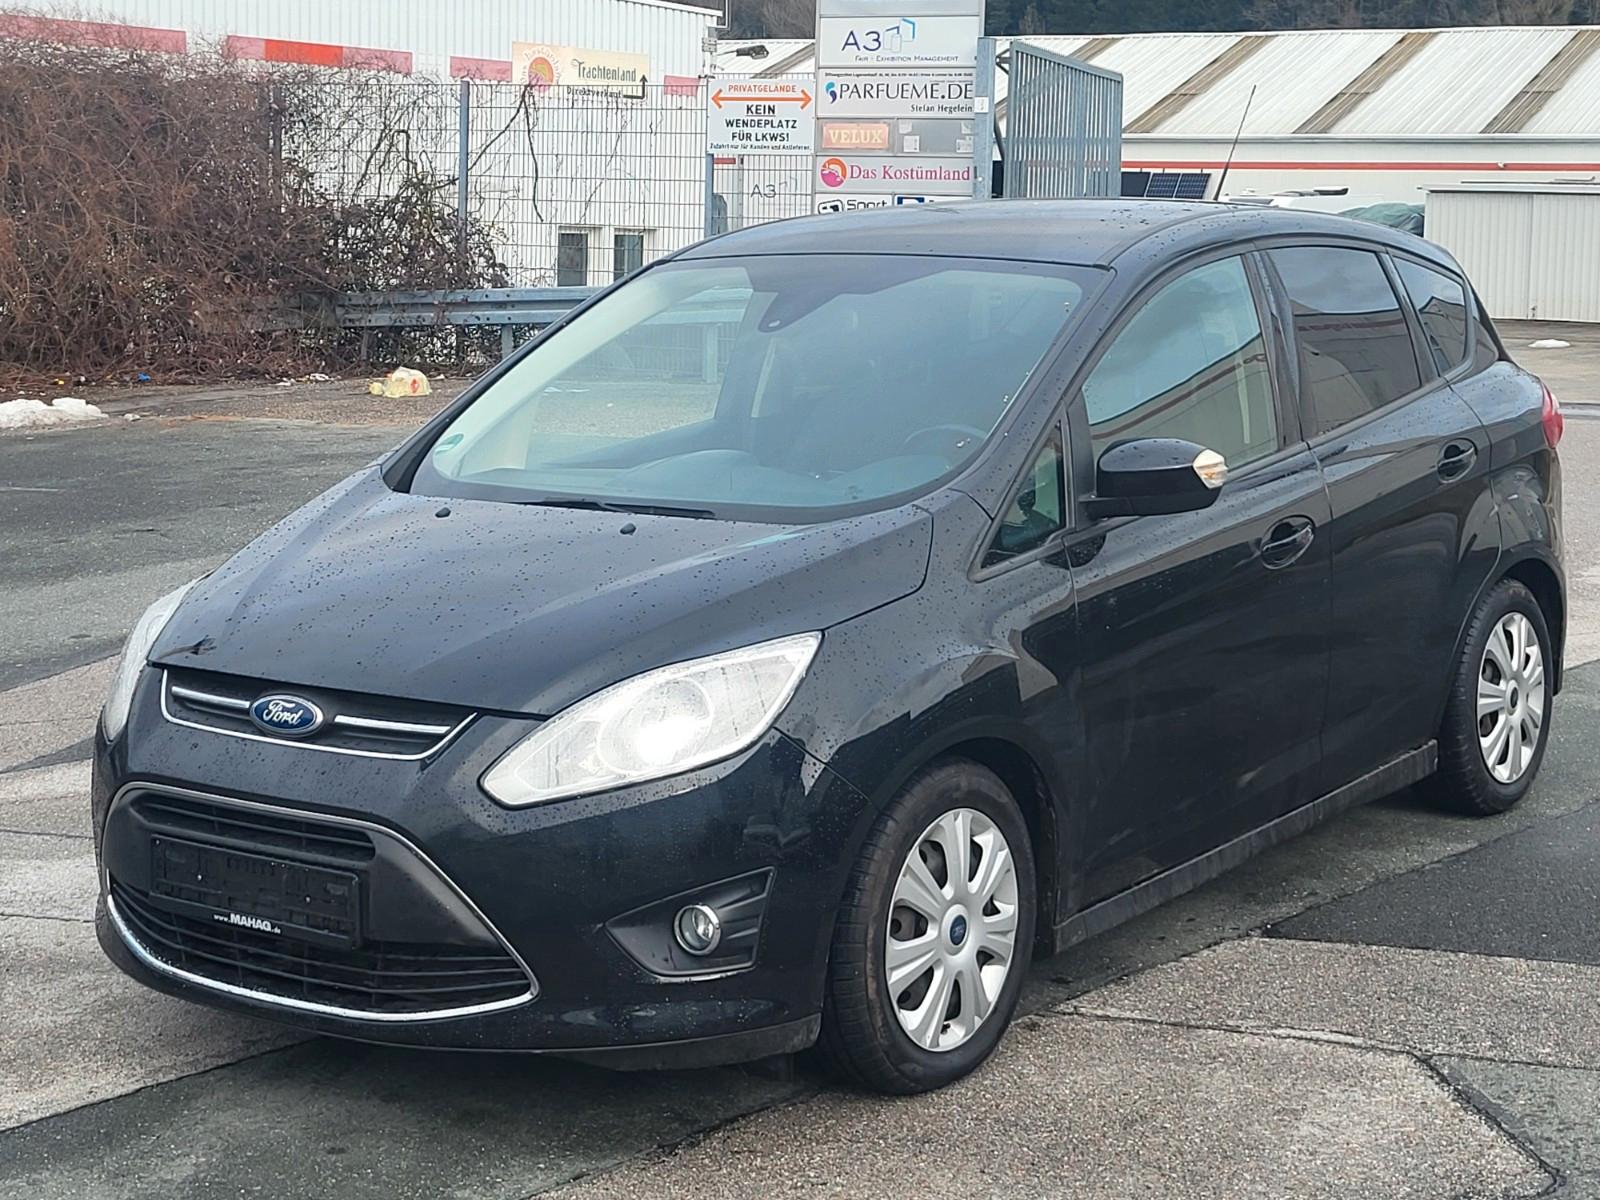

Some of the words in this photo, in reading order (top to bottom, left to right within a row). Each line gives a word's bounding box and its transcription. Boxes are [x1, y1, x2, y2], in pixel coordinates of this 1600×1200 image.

[841, 30, 882, 52] A3
[571, 58, 637, 82] Trachtenland
[839, 82, 974, 100] PARFUEME.DE
[746, 104, 776, 115] KEIN
[910, 103, 935, 113] Stefan
[937, 103, 973, 115] Hegelein
[725, 118, 798, 129] WENDEPLATZ
[731, 130, 752, 142] FÜR
[755, 132, 790, 142] LKWS!
[829, 129, 883, 144] VELUX
[850, 165, 877, 180] Das
[882, 165, 970, 181] Kostümland
[751, 184, 777, 199] A3
[262, 699, 304, 725] Ford
